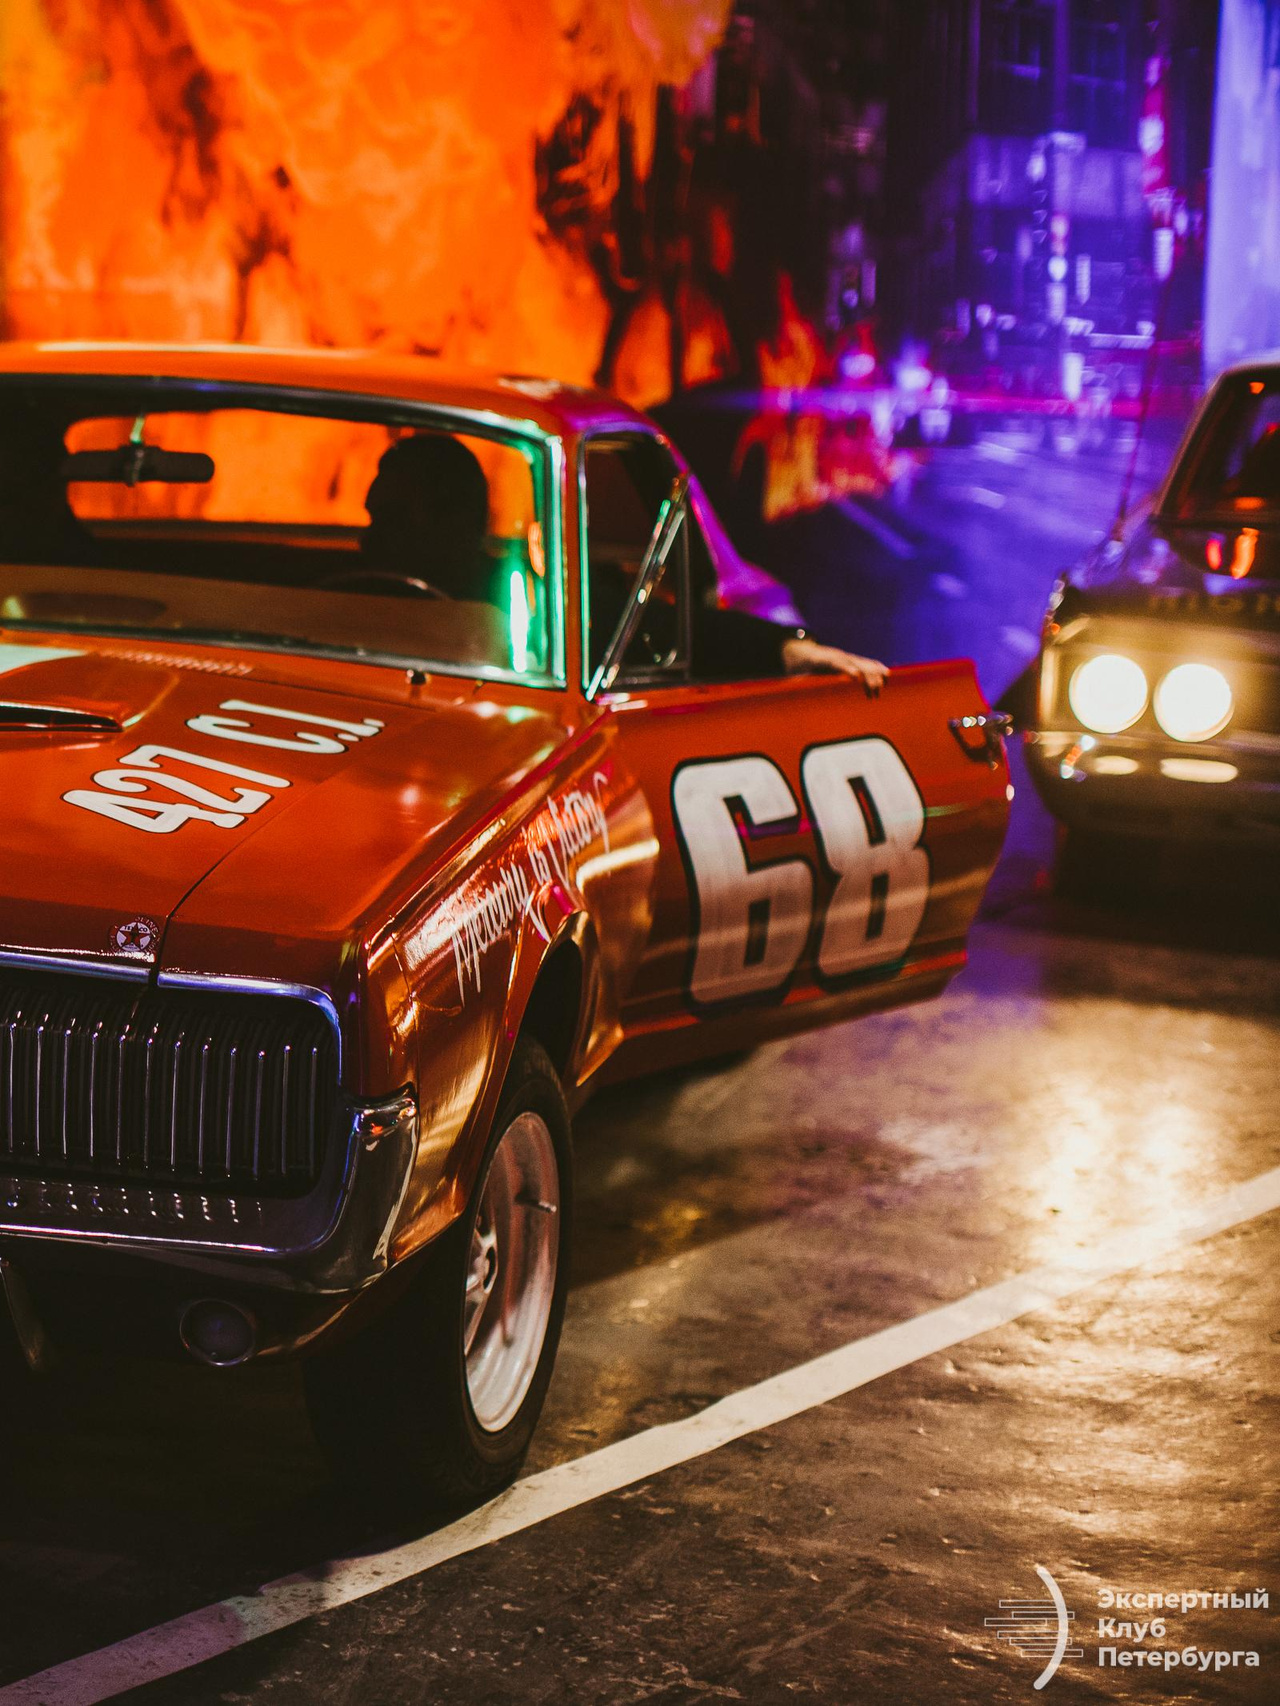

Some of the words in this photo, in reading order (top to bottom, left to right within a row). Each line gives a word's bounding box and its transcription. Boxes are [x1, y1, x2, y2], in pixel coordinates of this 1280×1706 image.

[61, 744, 292, 834] 427
[185, 699, 386, 754] C.I.
[671, 734, 932, 1010] 68
